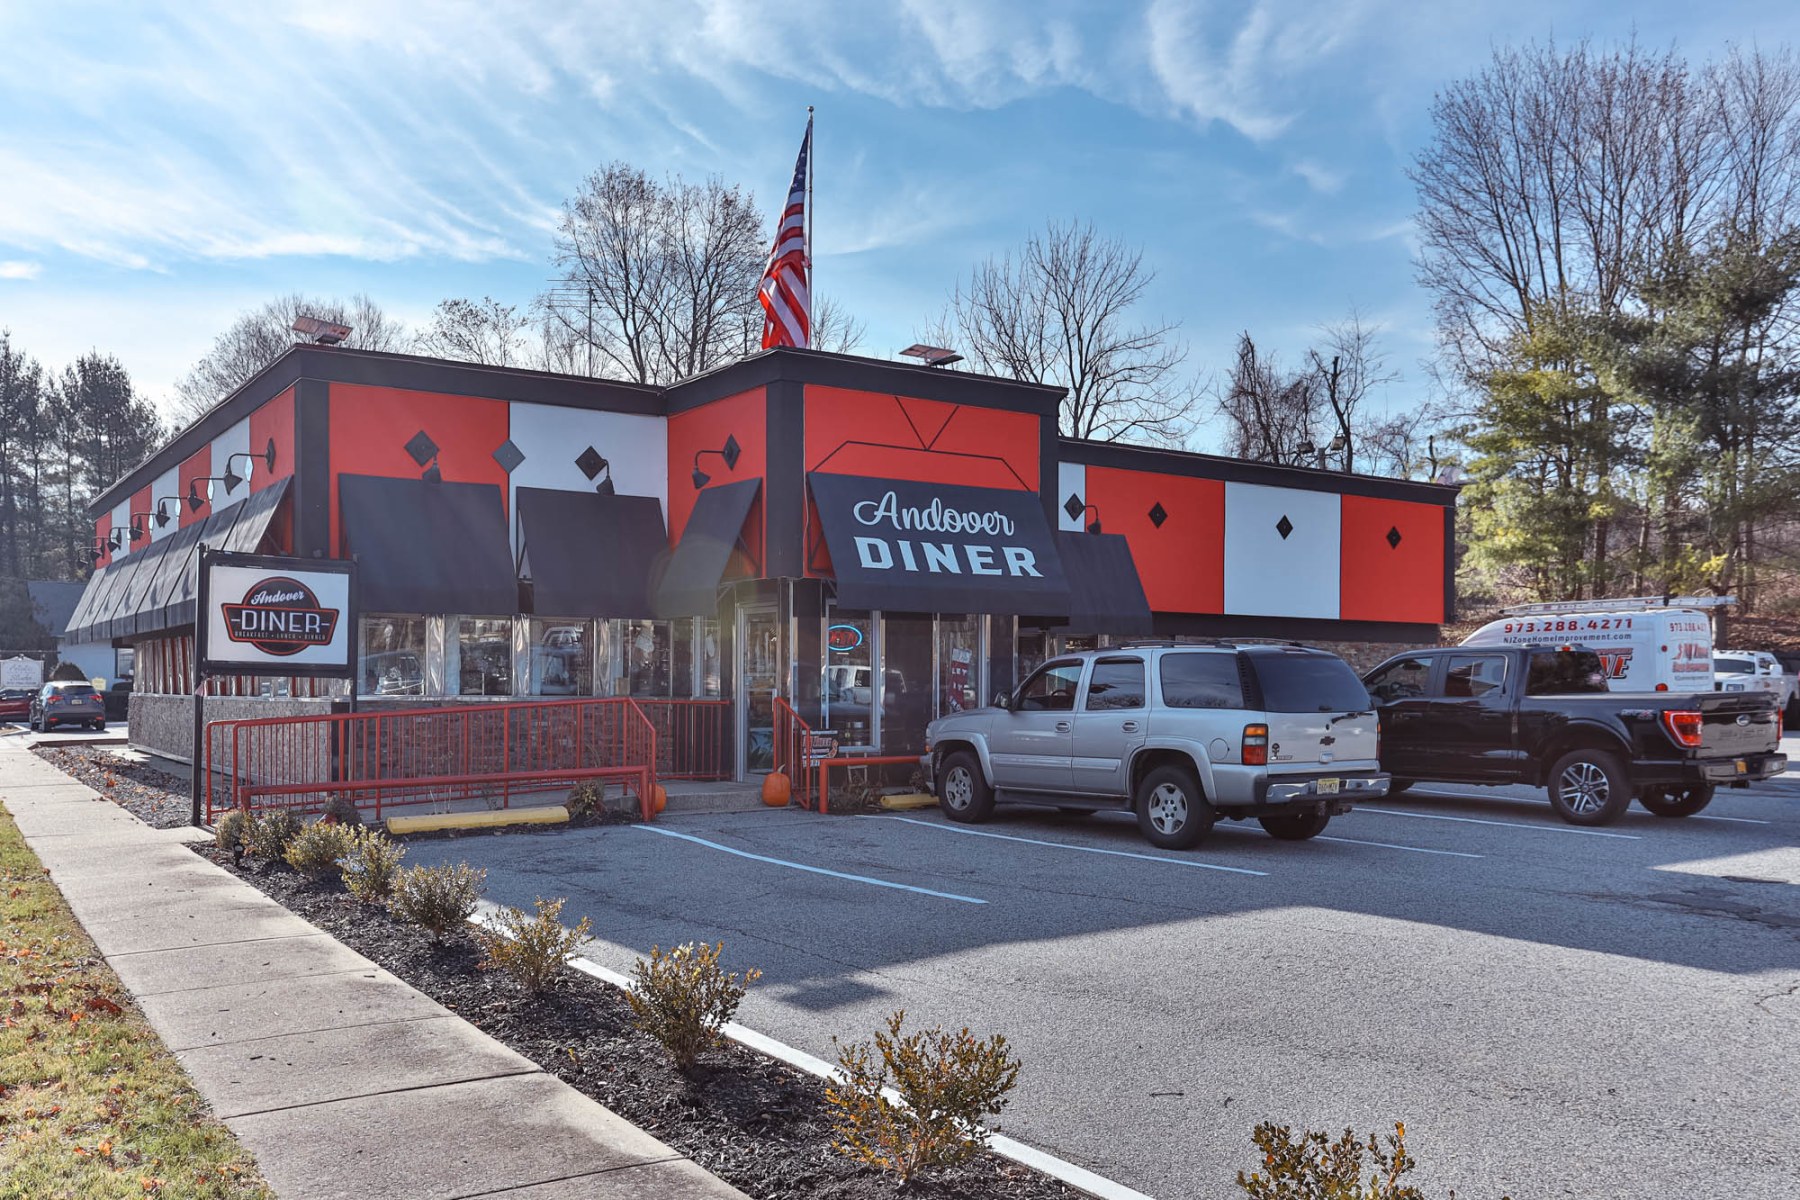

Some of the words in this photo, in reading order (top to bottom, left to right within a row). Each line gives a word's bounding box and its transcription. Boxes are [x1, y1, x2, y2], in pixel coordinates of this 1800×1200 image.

[853, 491, 1014, 536] Andover
[853, 536, 1044, 577] DINER
[251, 590, 305, 606] Andover
[241, 609, 320, 633] DINER
[1504, 618, 1633, 634] 973.288.4271
[1503, 633, 1632, 644] NJZoneHomeImprovement.com
